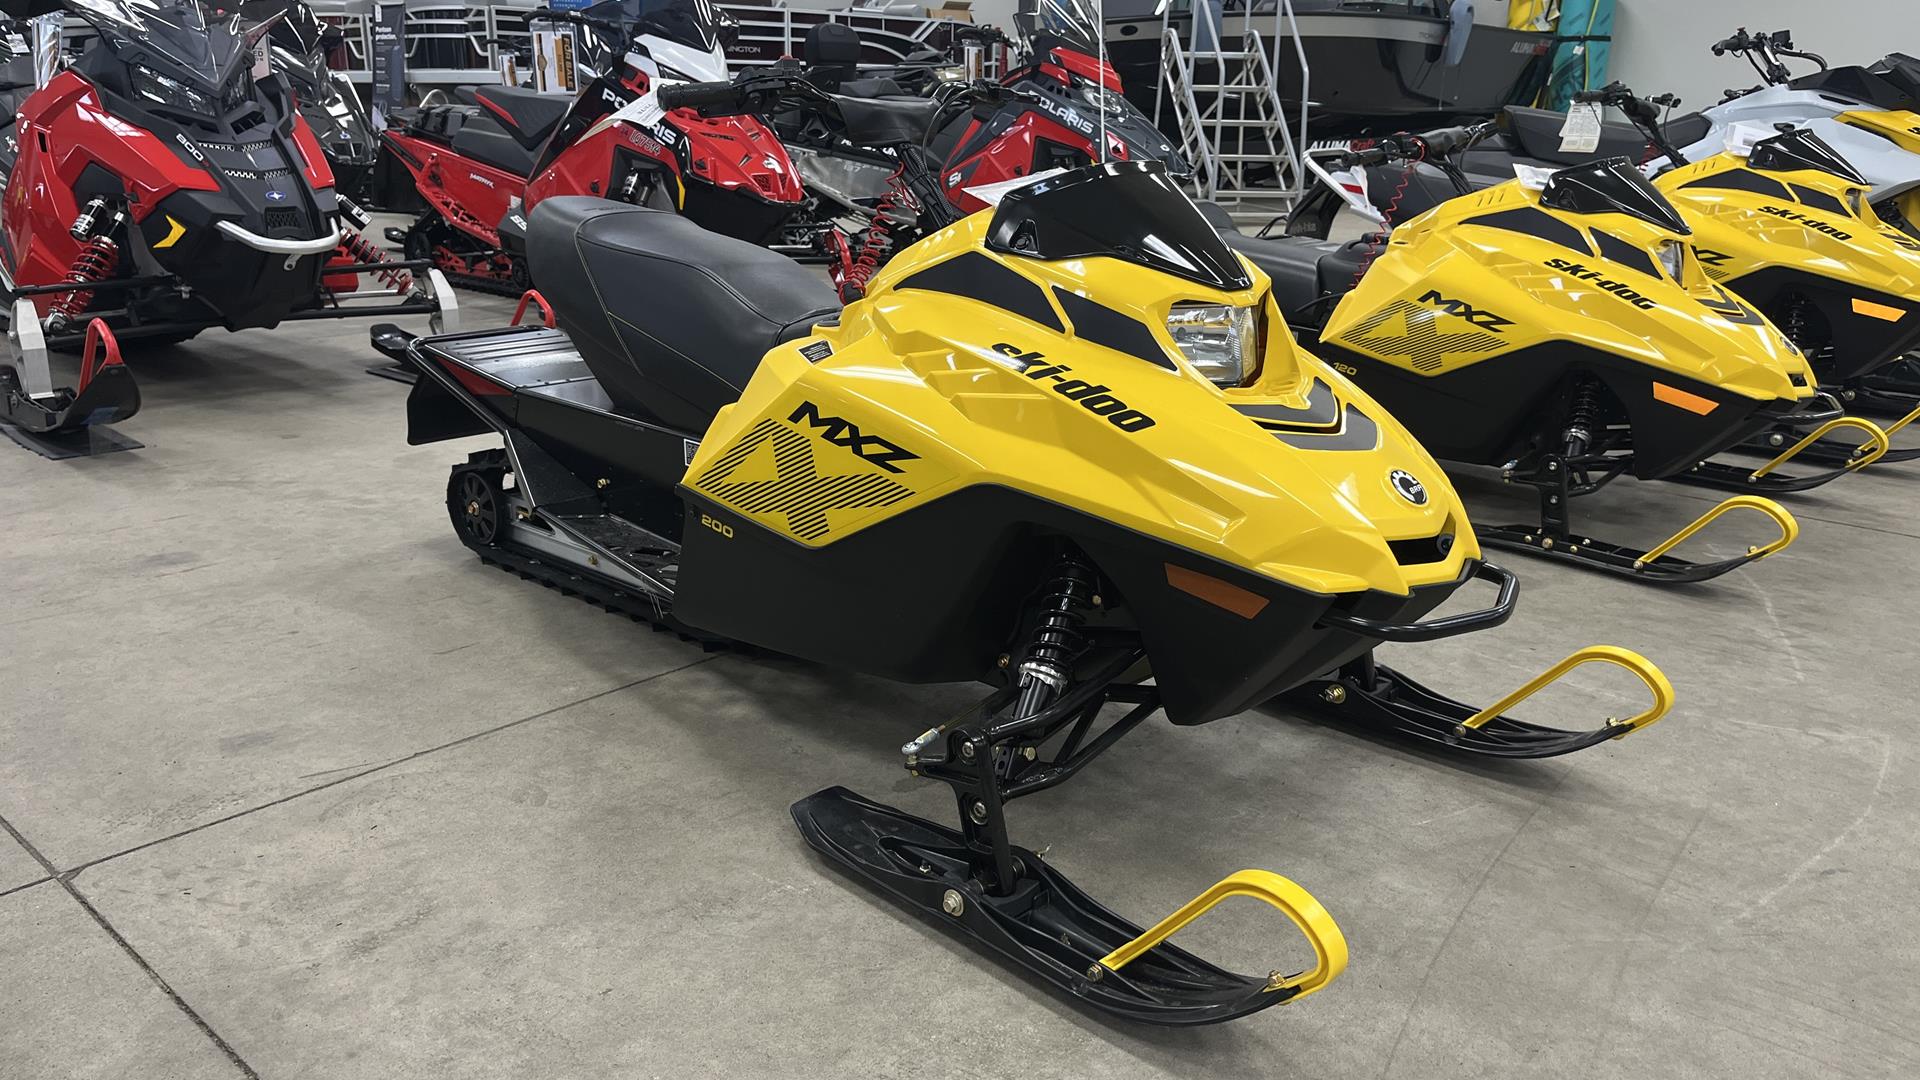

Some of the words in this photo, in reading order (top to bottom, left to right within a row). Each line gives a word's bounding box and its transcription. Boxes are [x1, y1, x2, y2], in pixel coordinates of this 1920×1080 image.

[1029, 90, 1095, 134] OLARIS
[1757, 205, 1853, 241] ski-doo
[1416, 289, 1517, 333] MXZ
[991, 342, 1157, 433] ski-doo
[1333, 362, 1358, 376] 120
[787, 400, 923, 474] MXZ
[1408, 484, 1422, 494] BRP
[701, 513, 734, 539] 200
